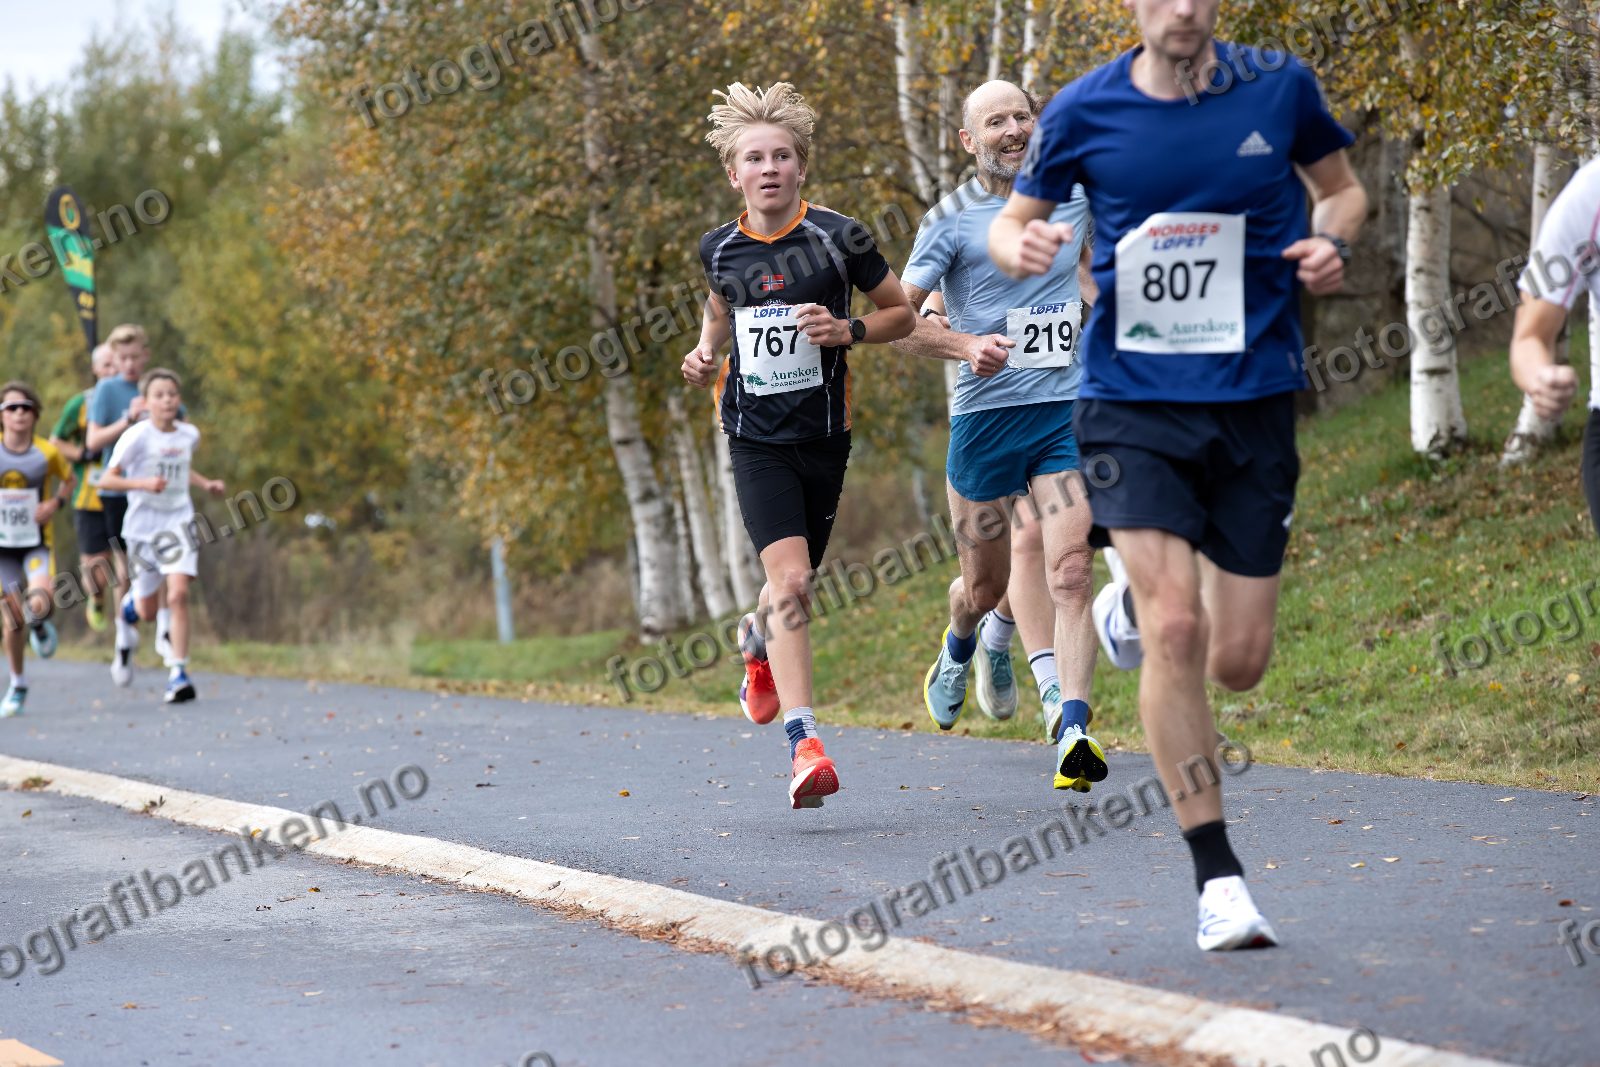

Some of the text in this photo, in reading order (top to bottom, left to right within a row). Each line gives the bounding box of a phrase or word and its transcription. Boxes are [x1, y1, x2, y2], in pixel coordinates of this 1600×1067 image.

[1147, 222, 1221, 238] NORGES
[1152, 235, 1207, 251] LØPET
[1142, 259, 1217, 302] 807
[753, 306, 791, 319] LØPET
[1030, 303, 1067, 315] LØPET
[748, 325, 800, 357] 767
[1023, 320, 1073, 354] 219
[770, 366, 819, 382] Aurskog
